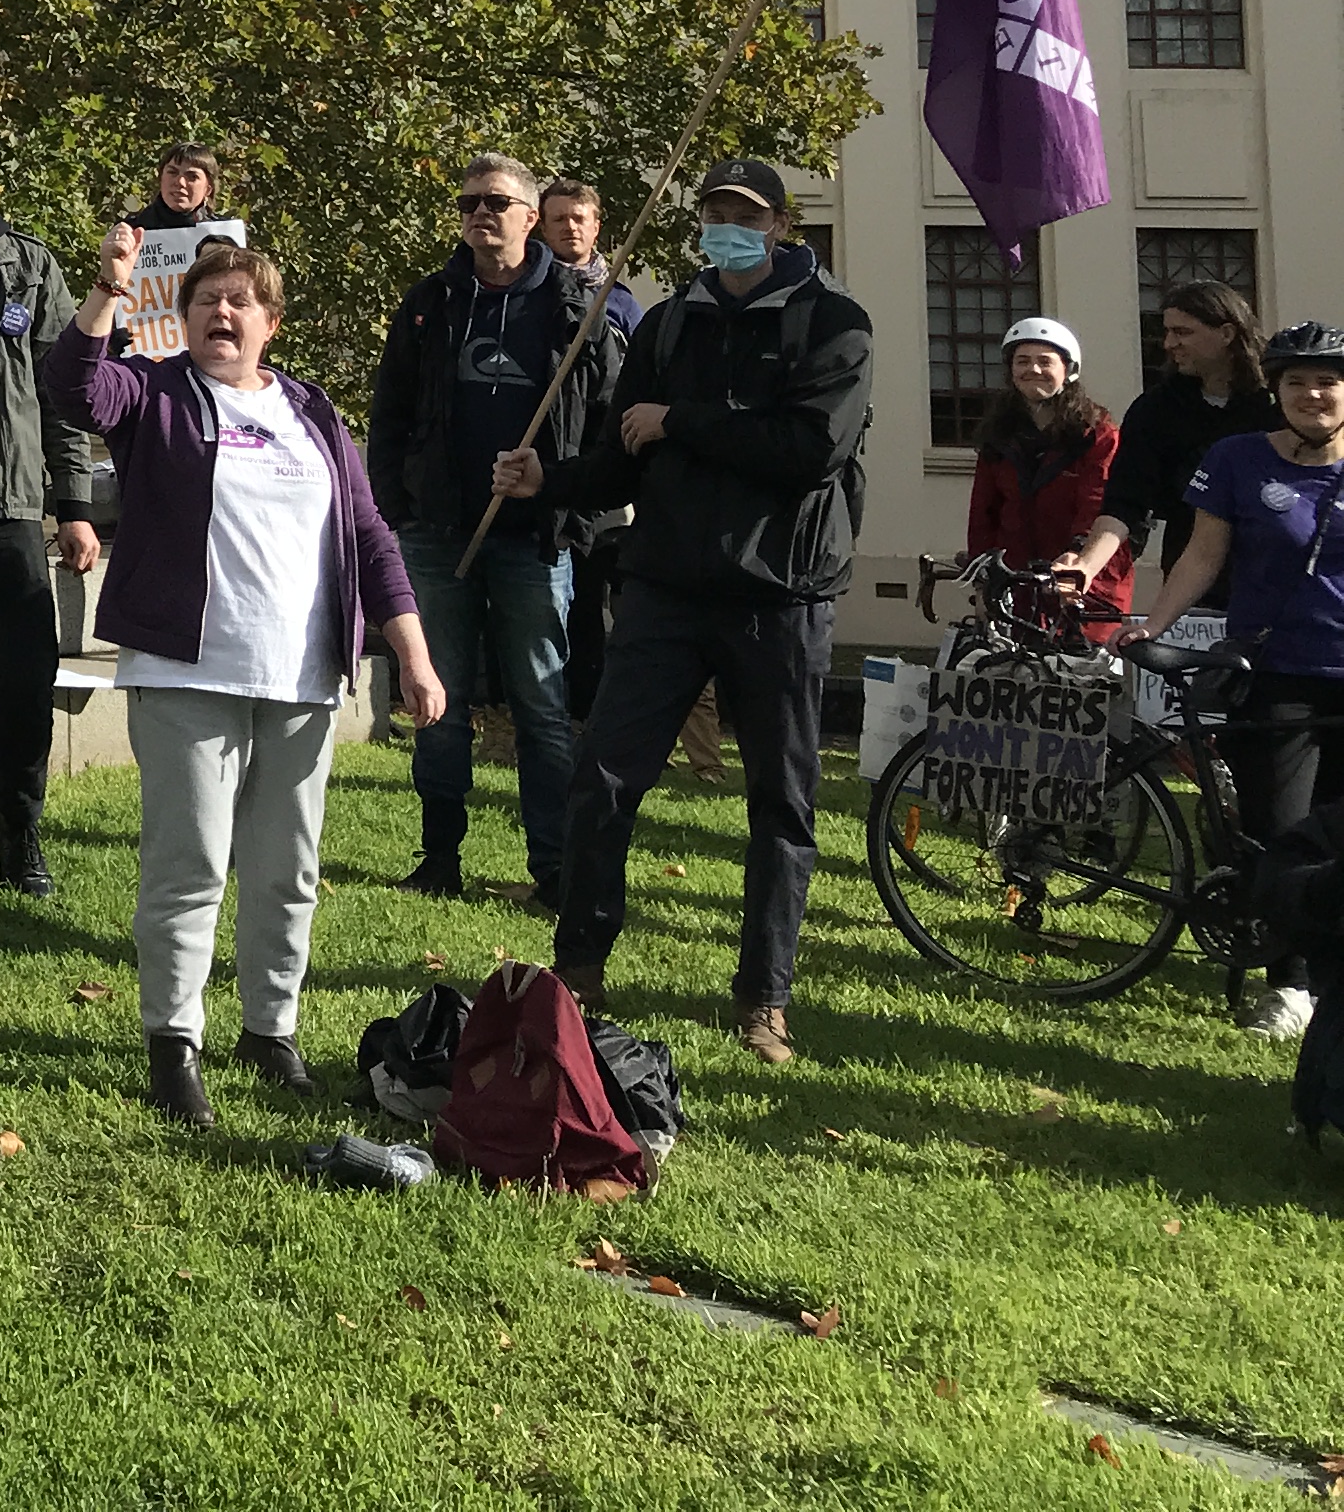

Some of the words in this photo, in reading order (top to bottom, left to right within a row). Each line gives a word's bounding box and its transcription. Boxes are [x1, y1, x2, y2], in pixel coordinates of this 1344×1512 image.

[141, 256, 162, 268] JOB,
[164, 253, 187, 267] DAN!
[274, 466, 304, 477] JOIN
[928, 671, 1108, 737] WORKERS
[1036, 730, 1106, 781] PAY
[922, 756, 979, 810] FOR
[980, 766, 1030, 817] THE
[1032, 775, 1104, 824] CRISIS
